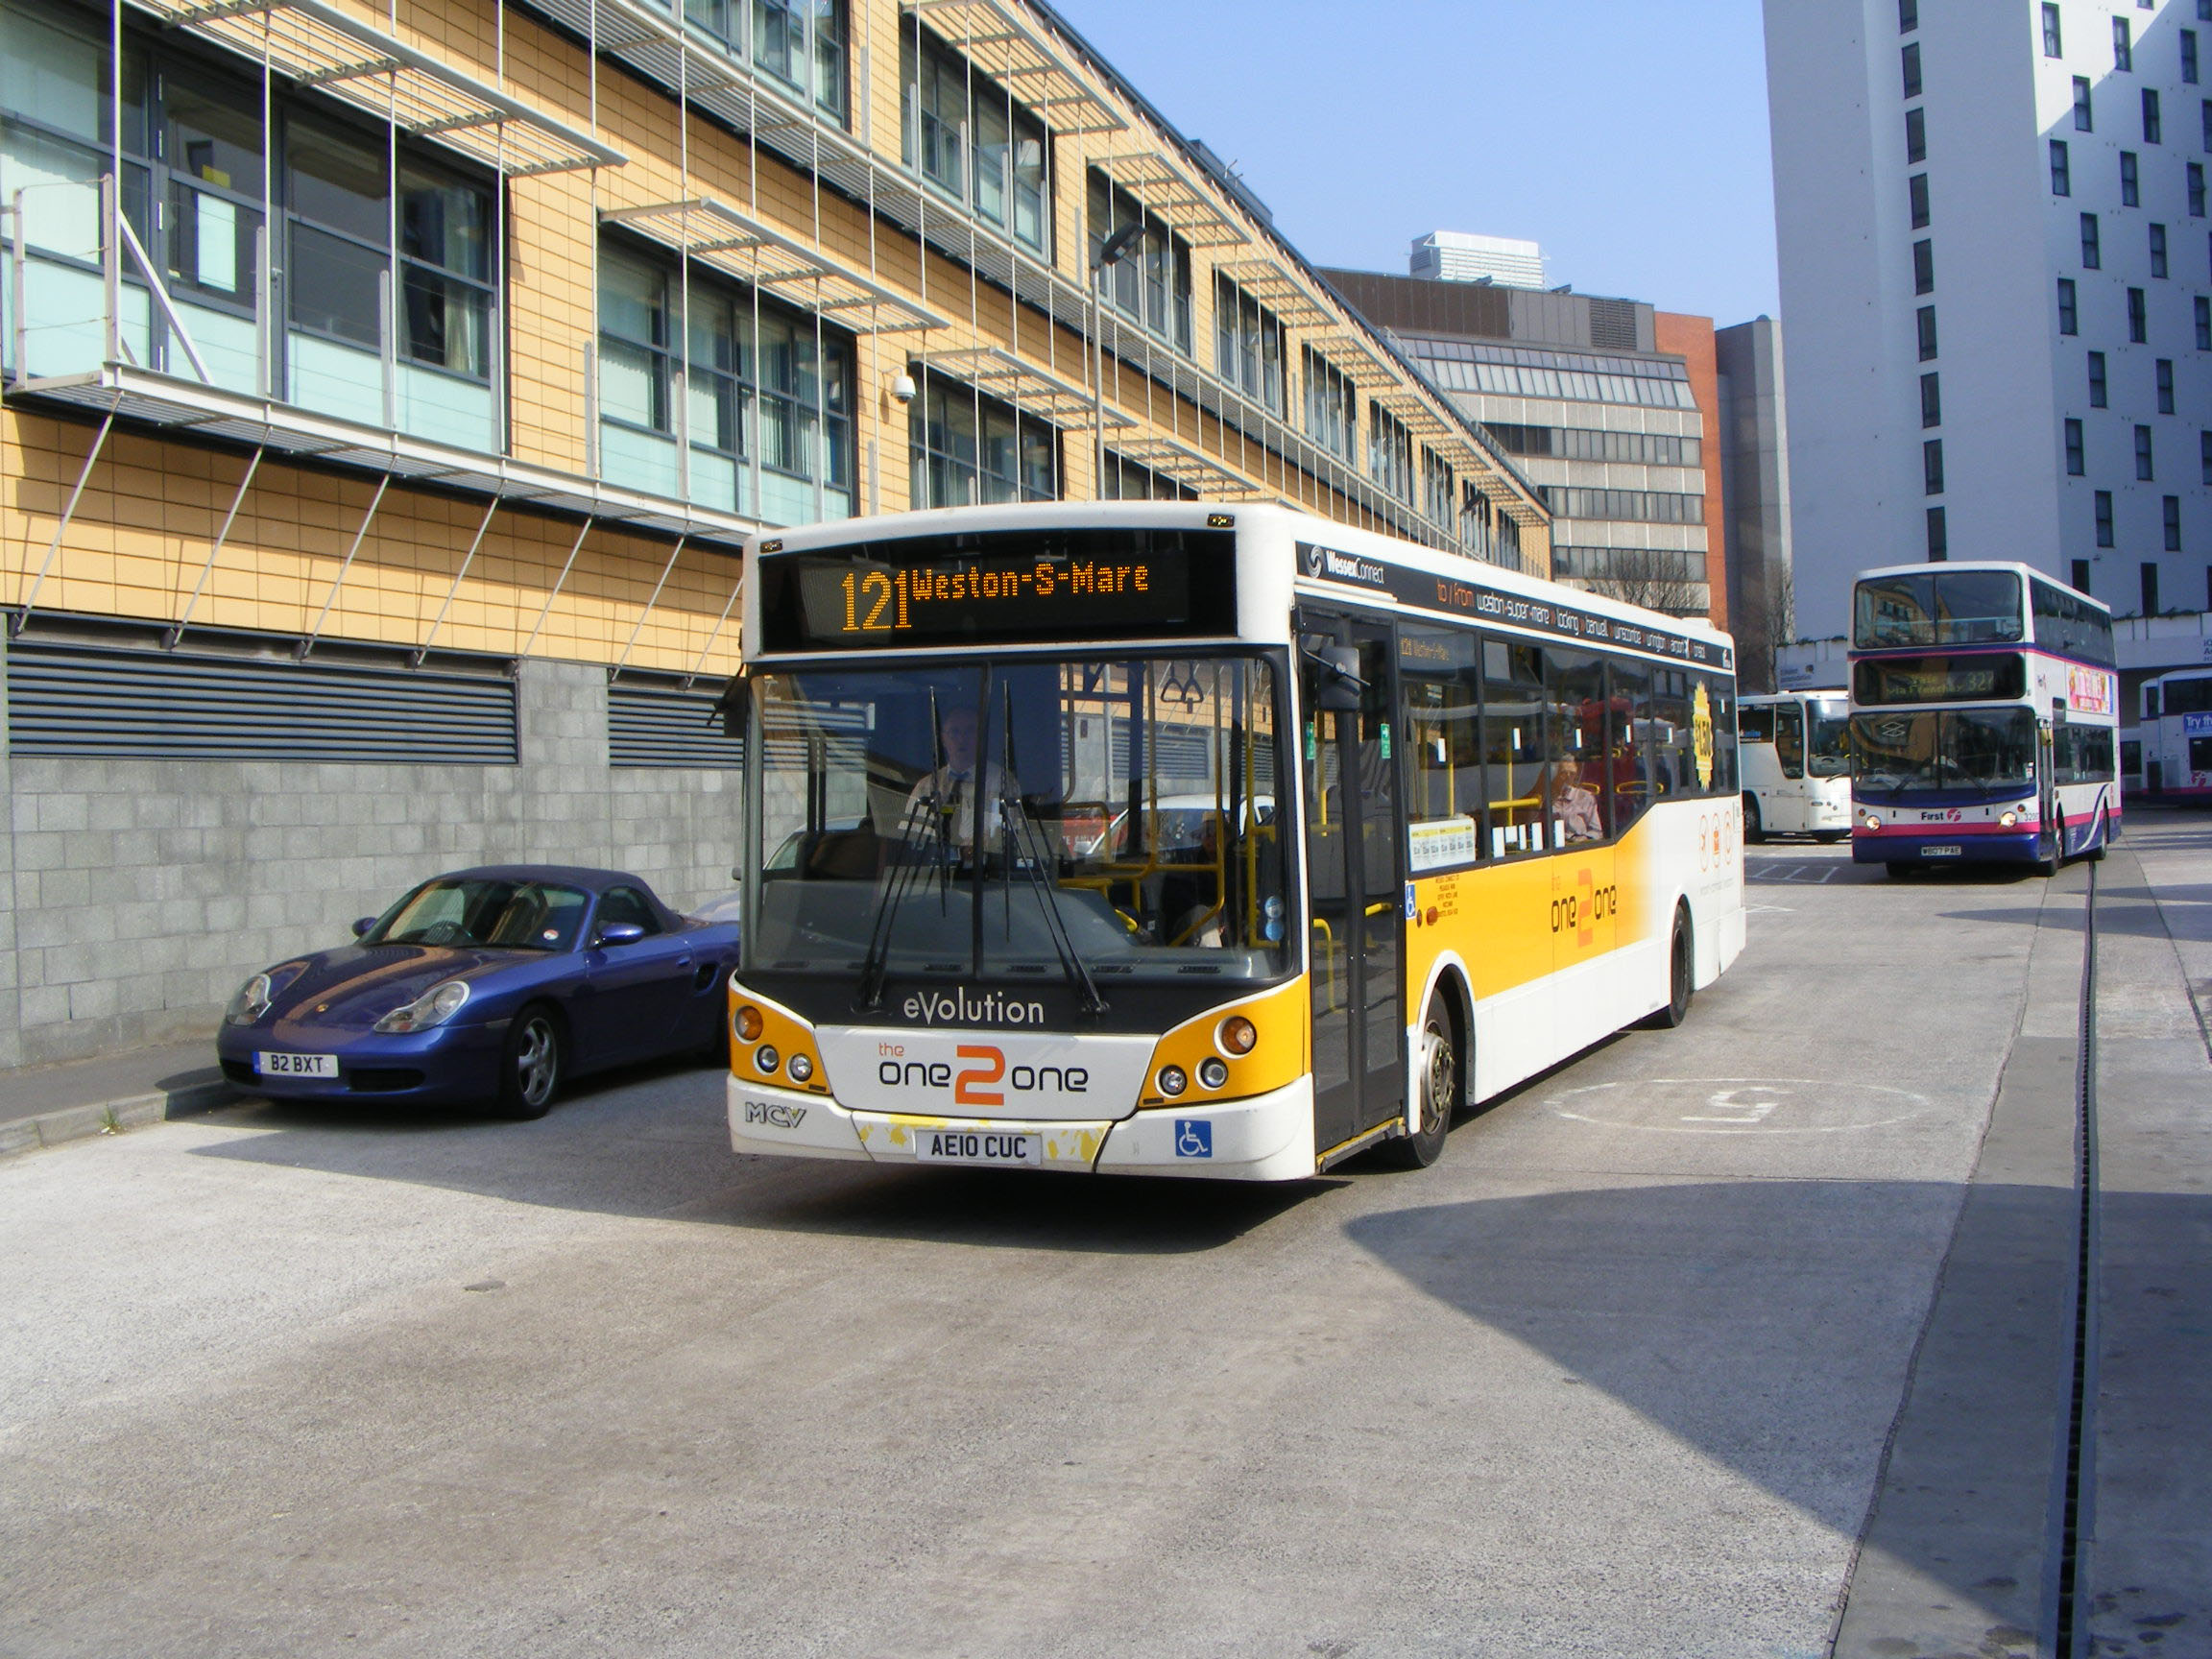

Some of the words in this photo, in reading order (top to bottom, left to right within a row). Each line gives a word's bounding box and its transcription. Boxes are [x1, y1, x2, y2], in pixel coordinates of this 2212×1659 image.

[842, 571, 911, 632] 121
[912, 562, 1149, 601] Weston-S-Mare
[2186, 716, 2200, 730] Try
[1921, 811, 1944, 821] First
[903, 987, 1044, 1024] eVolution
[878, 1043, 904, 1057] the
[271, 1055, 289, 1071] B2
[293, 1056, 324, 1072] BXT
[879, 1058, 950, 1088] one
[955, 1045, 1005, 1106] 2
[1011, 1065, 1089, 1093] one
[745, 1102, 807, 1128] MCV
[930, 1134, 978, 1158] AE10
[985, 1136, 1028, 1159] CUC
